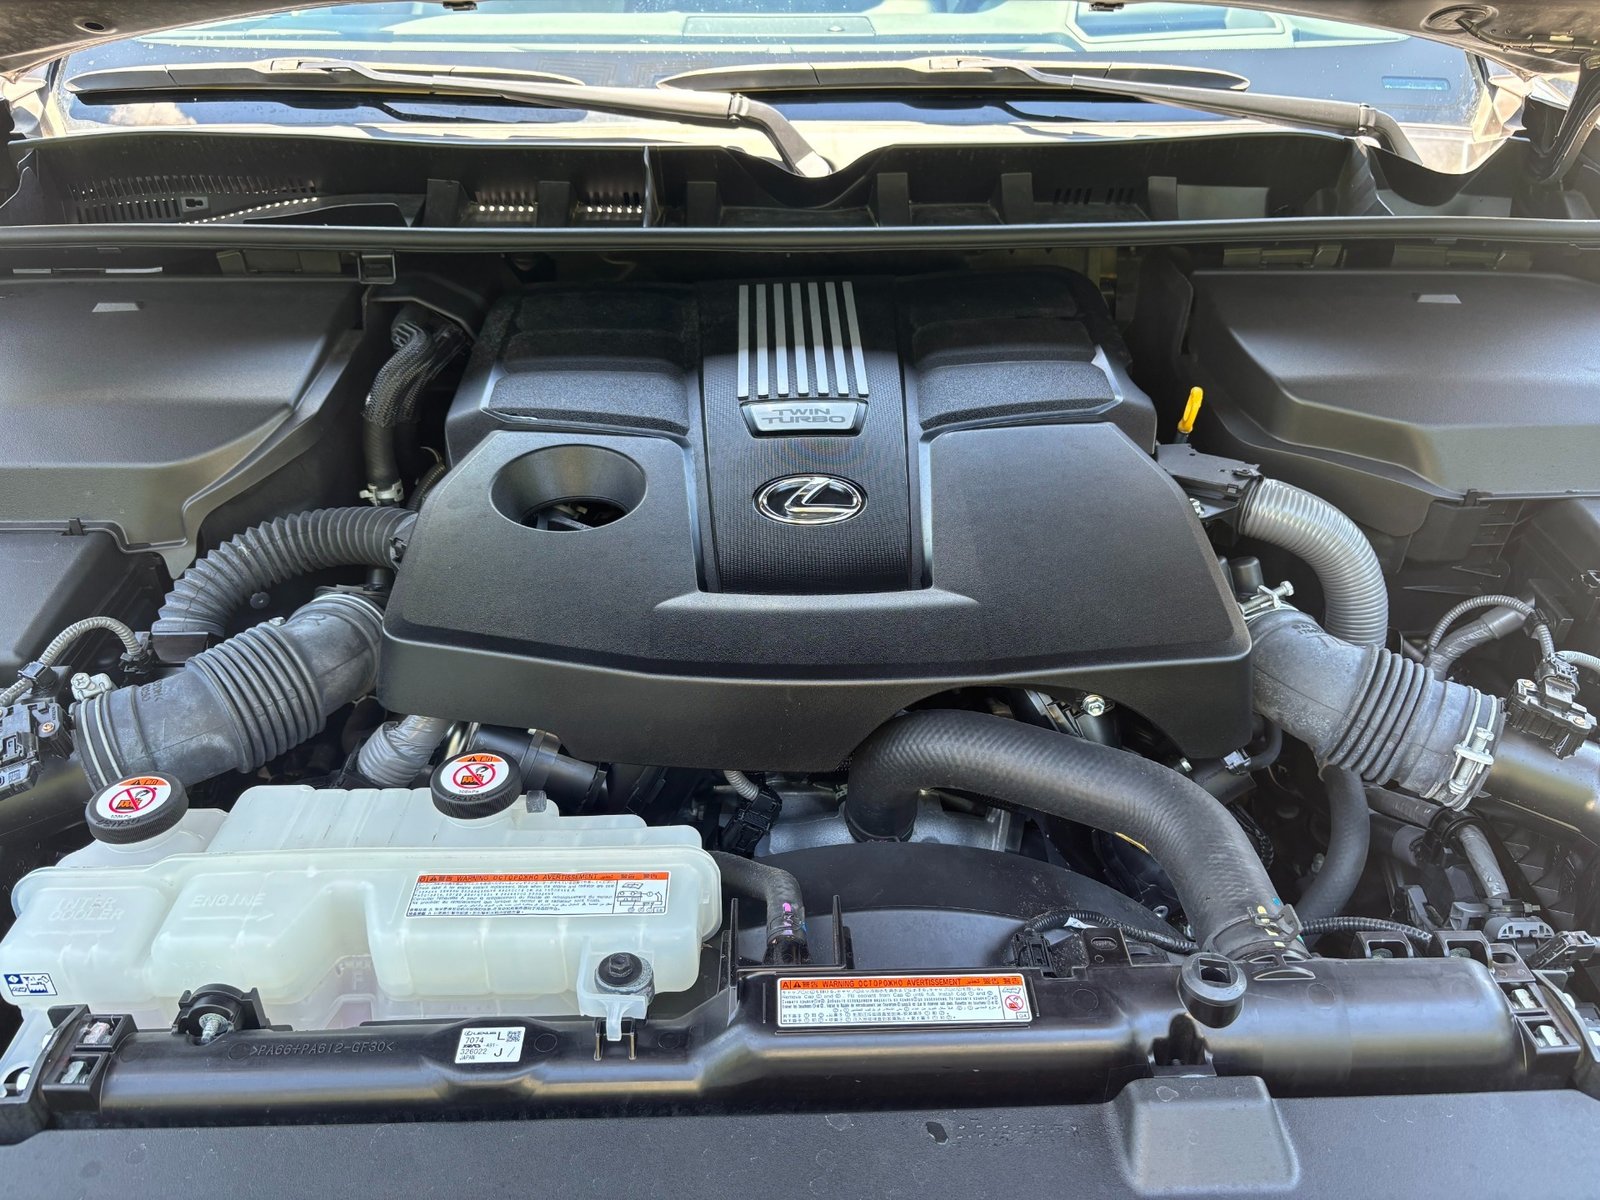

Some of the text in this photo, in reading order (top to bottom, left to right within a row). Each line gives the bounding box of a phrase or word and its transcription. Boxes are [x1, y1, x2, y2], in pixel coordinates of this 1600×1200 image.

[762, 416, 845, 424] TURBO
[191, 893, 266, 907] ENGINE
[48, 909, 125, 921] COOLER
[497, 1032, 505, 1040] L
[494, 1048, 503, 1057] J
